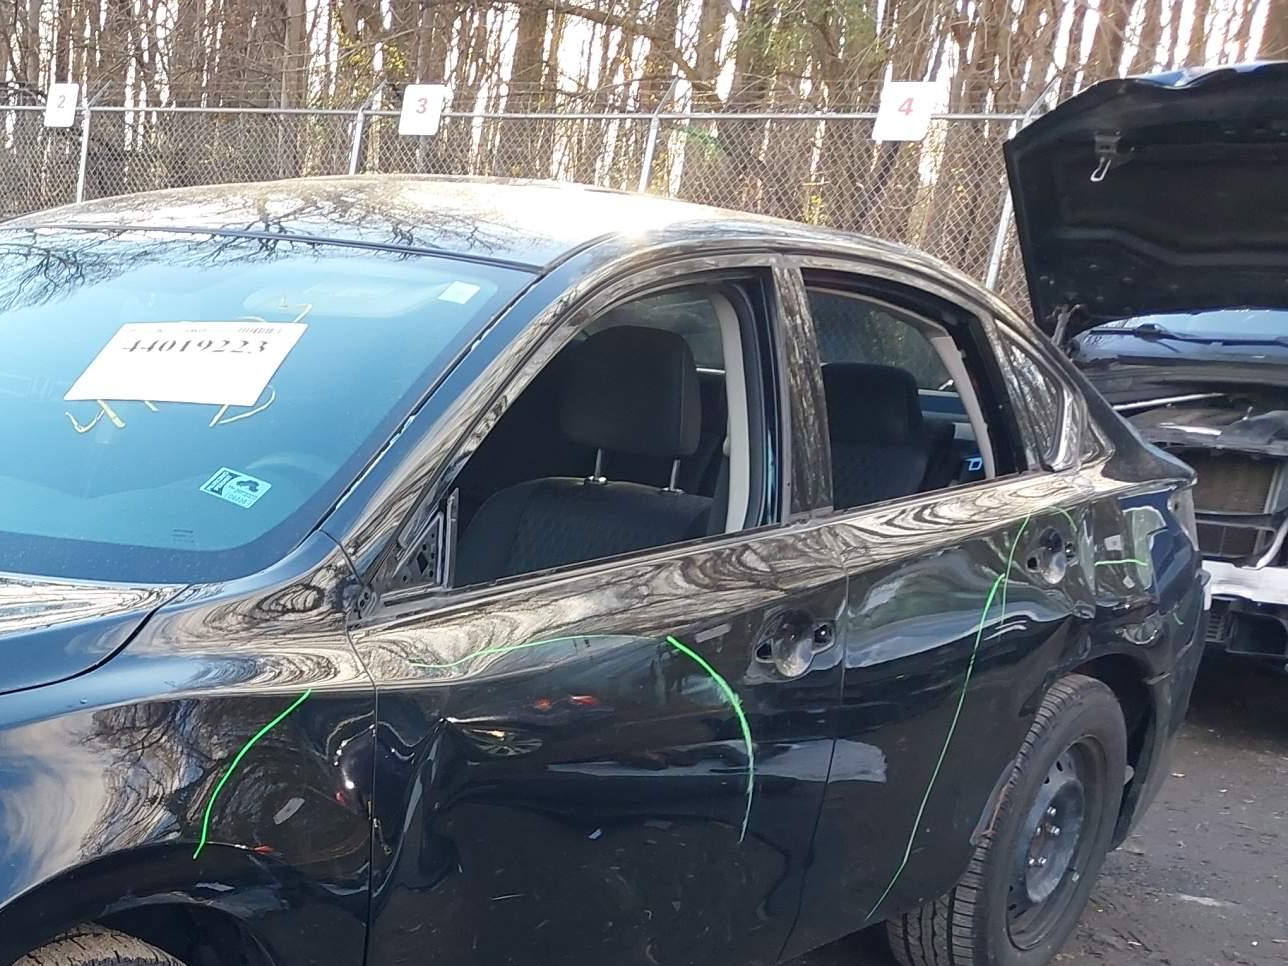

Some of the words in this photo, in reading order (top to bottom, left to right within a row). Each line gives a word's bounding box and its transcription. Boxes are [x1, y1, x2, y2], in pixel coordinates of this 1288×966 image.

[57, 94, 66, 109] 2
[416, 97, 428, 114] 3
[898, 97, 914, 116] 4
[121, 339, 269, 355] 44019223
